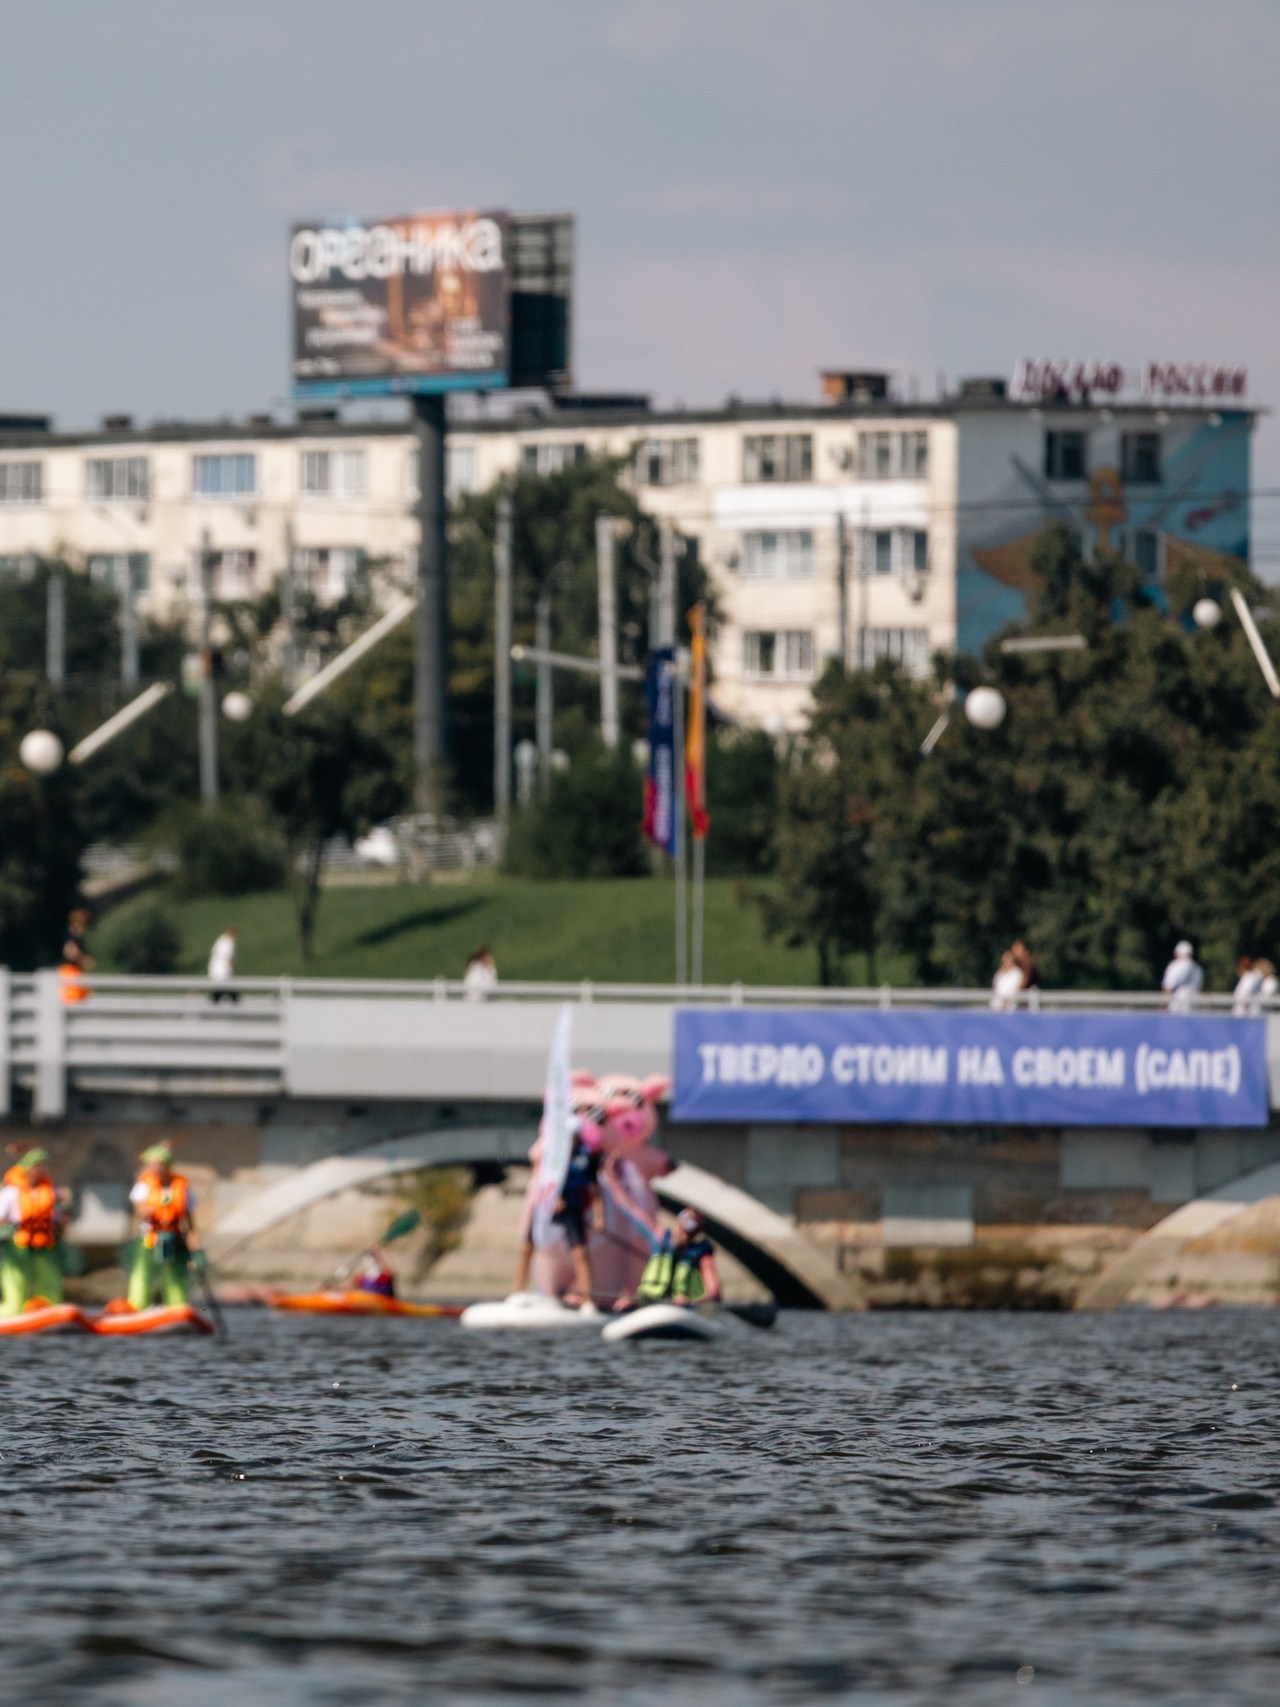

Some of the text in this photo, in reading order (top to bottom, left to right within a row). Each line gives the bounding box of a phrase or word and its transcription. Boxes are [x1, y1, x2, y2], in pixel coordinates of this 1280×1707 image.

[699, 1042, 1241, 1095] ТВЕРДО СТОИМ НА СВОЕМ (САПЕ)
